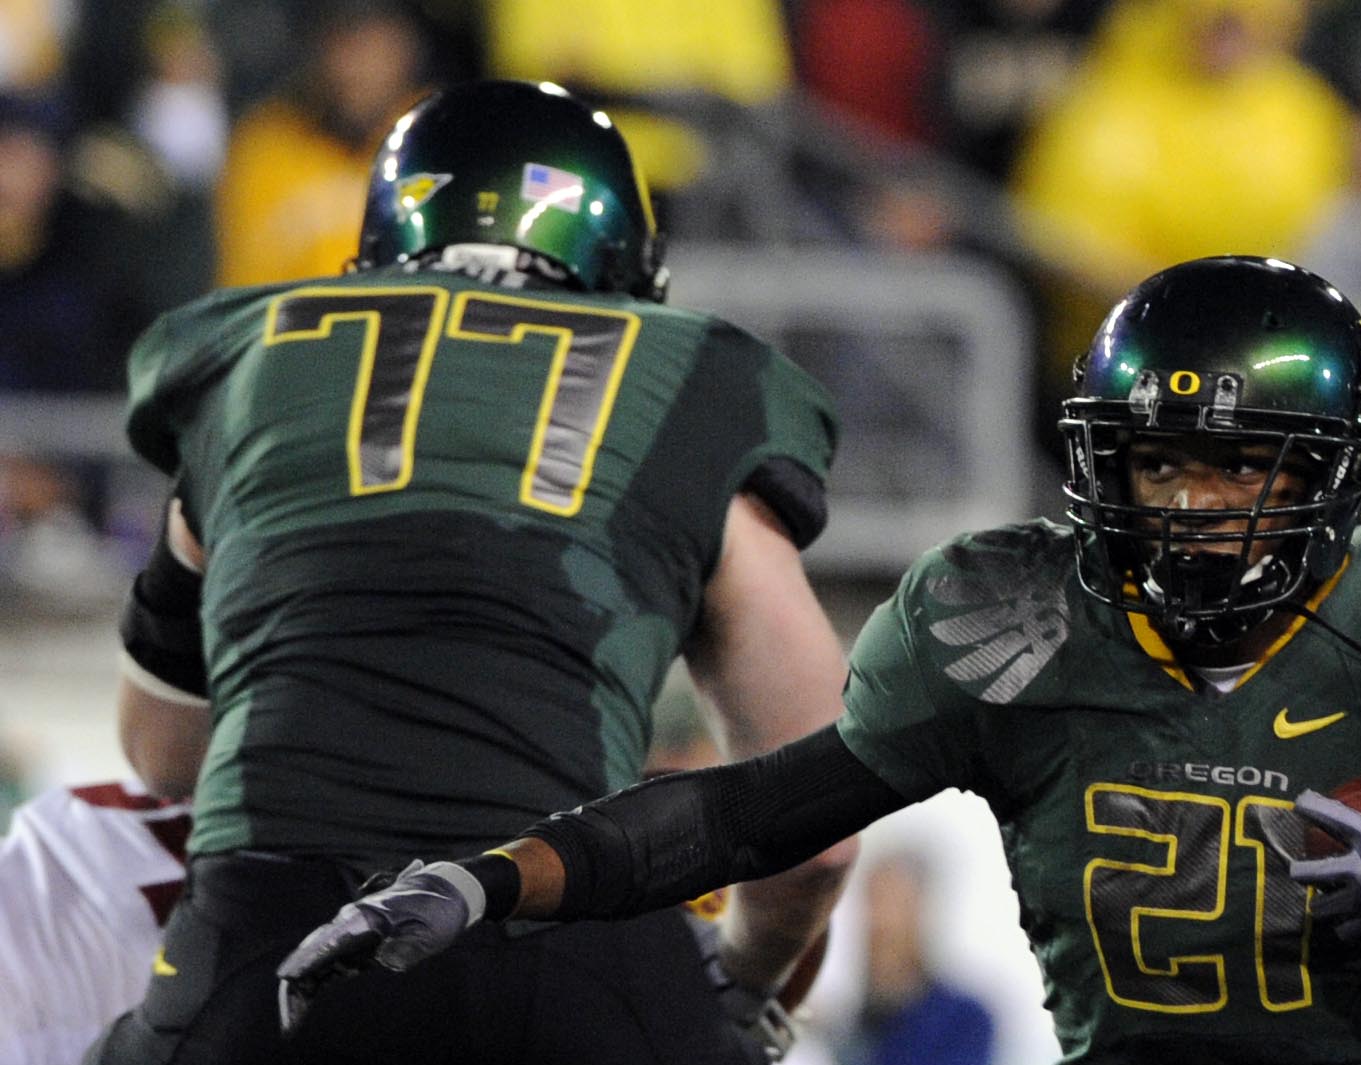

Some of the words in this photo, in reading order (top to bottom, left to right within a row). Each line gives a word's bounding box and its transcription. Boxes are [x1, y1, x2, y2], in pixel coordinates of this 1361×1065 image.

[263, 286, 641, 517] 77
[1169, 370, 1201, 395] O
[1084, 782, 1312, 1014] 21
